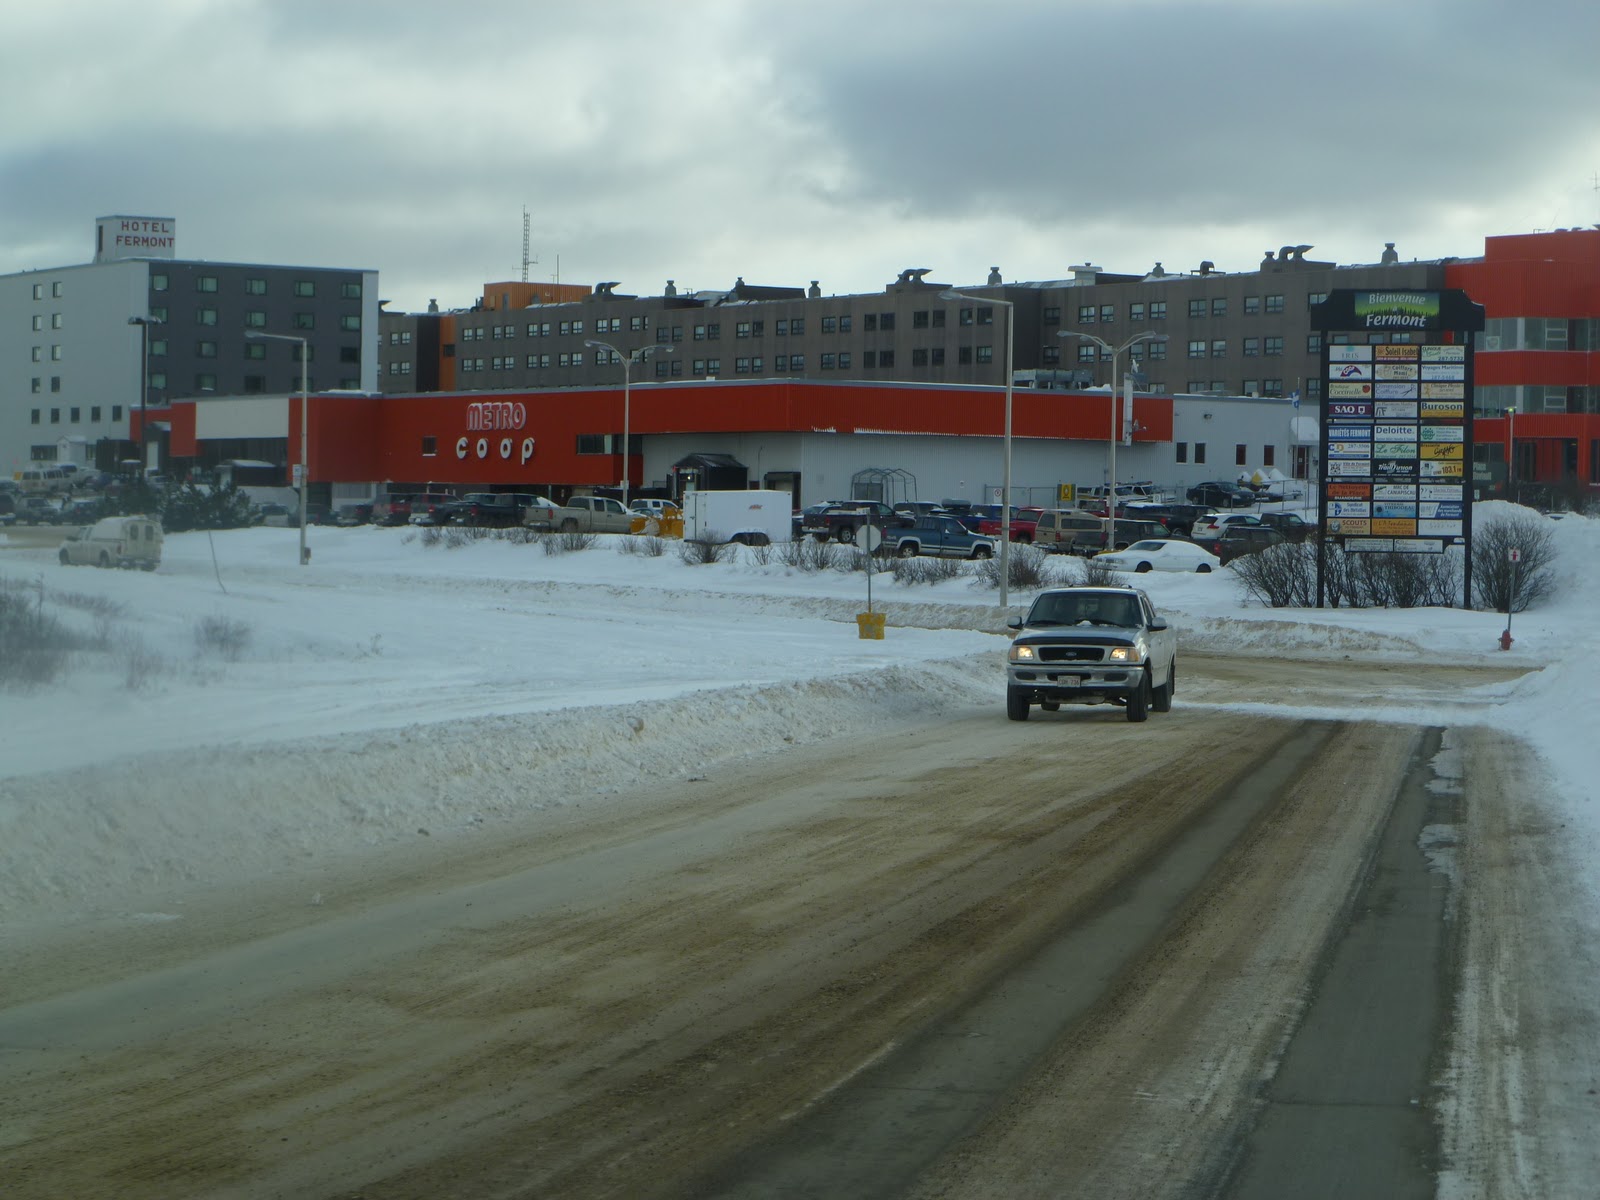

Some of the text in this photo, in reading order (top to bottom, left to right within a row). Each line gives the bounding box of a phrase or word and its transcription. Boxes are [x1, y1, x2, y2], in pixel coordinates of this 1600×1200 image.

[121, 221, 169, 233] HOTEL
[116, 235, 175, 248] FERMONT
[1368, 292, 1426, 305] Bienvenue
[1366, 314, 1426, 327] Fermont
[1335, 405, 1355, 414] SAQ
[1421, 402, 1463, 410] Buroson
[466, 402, 527, 431] METRO
